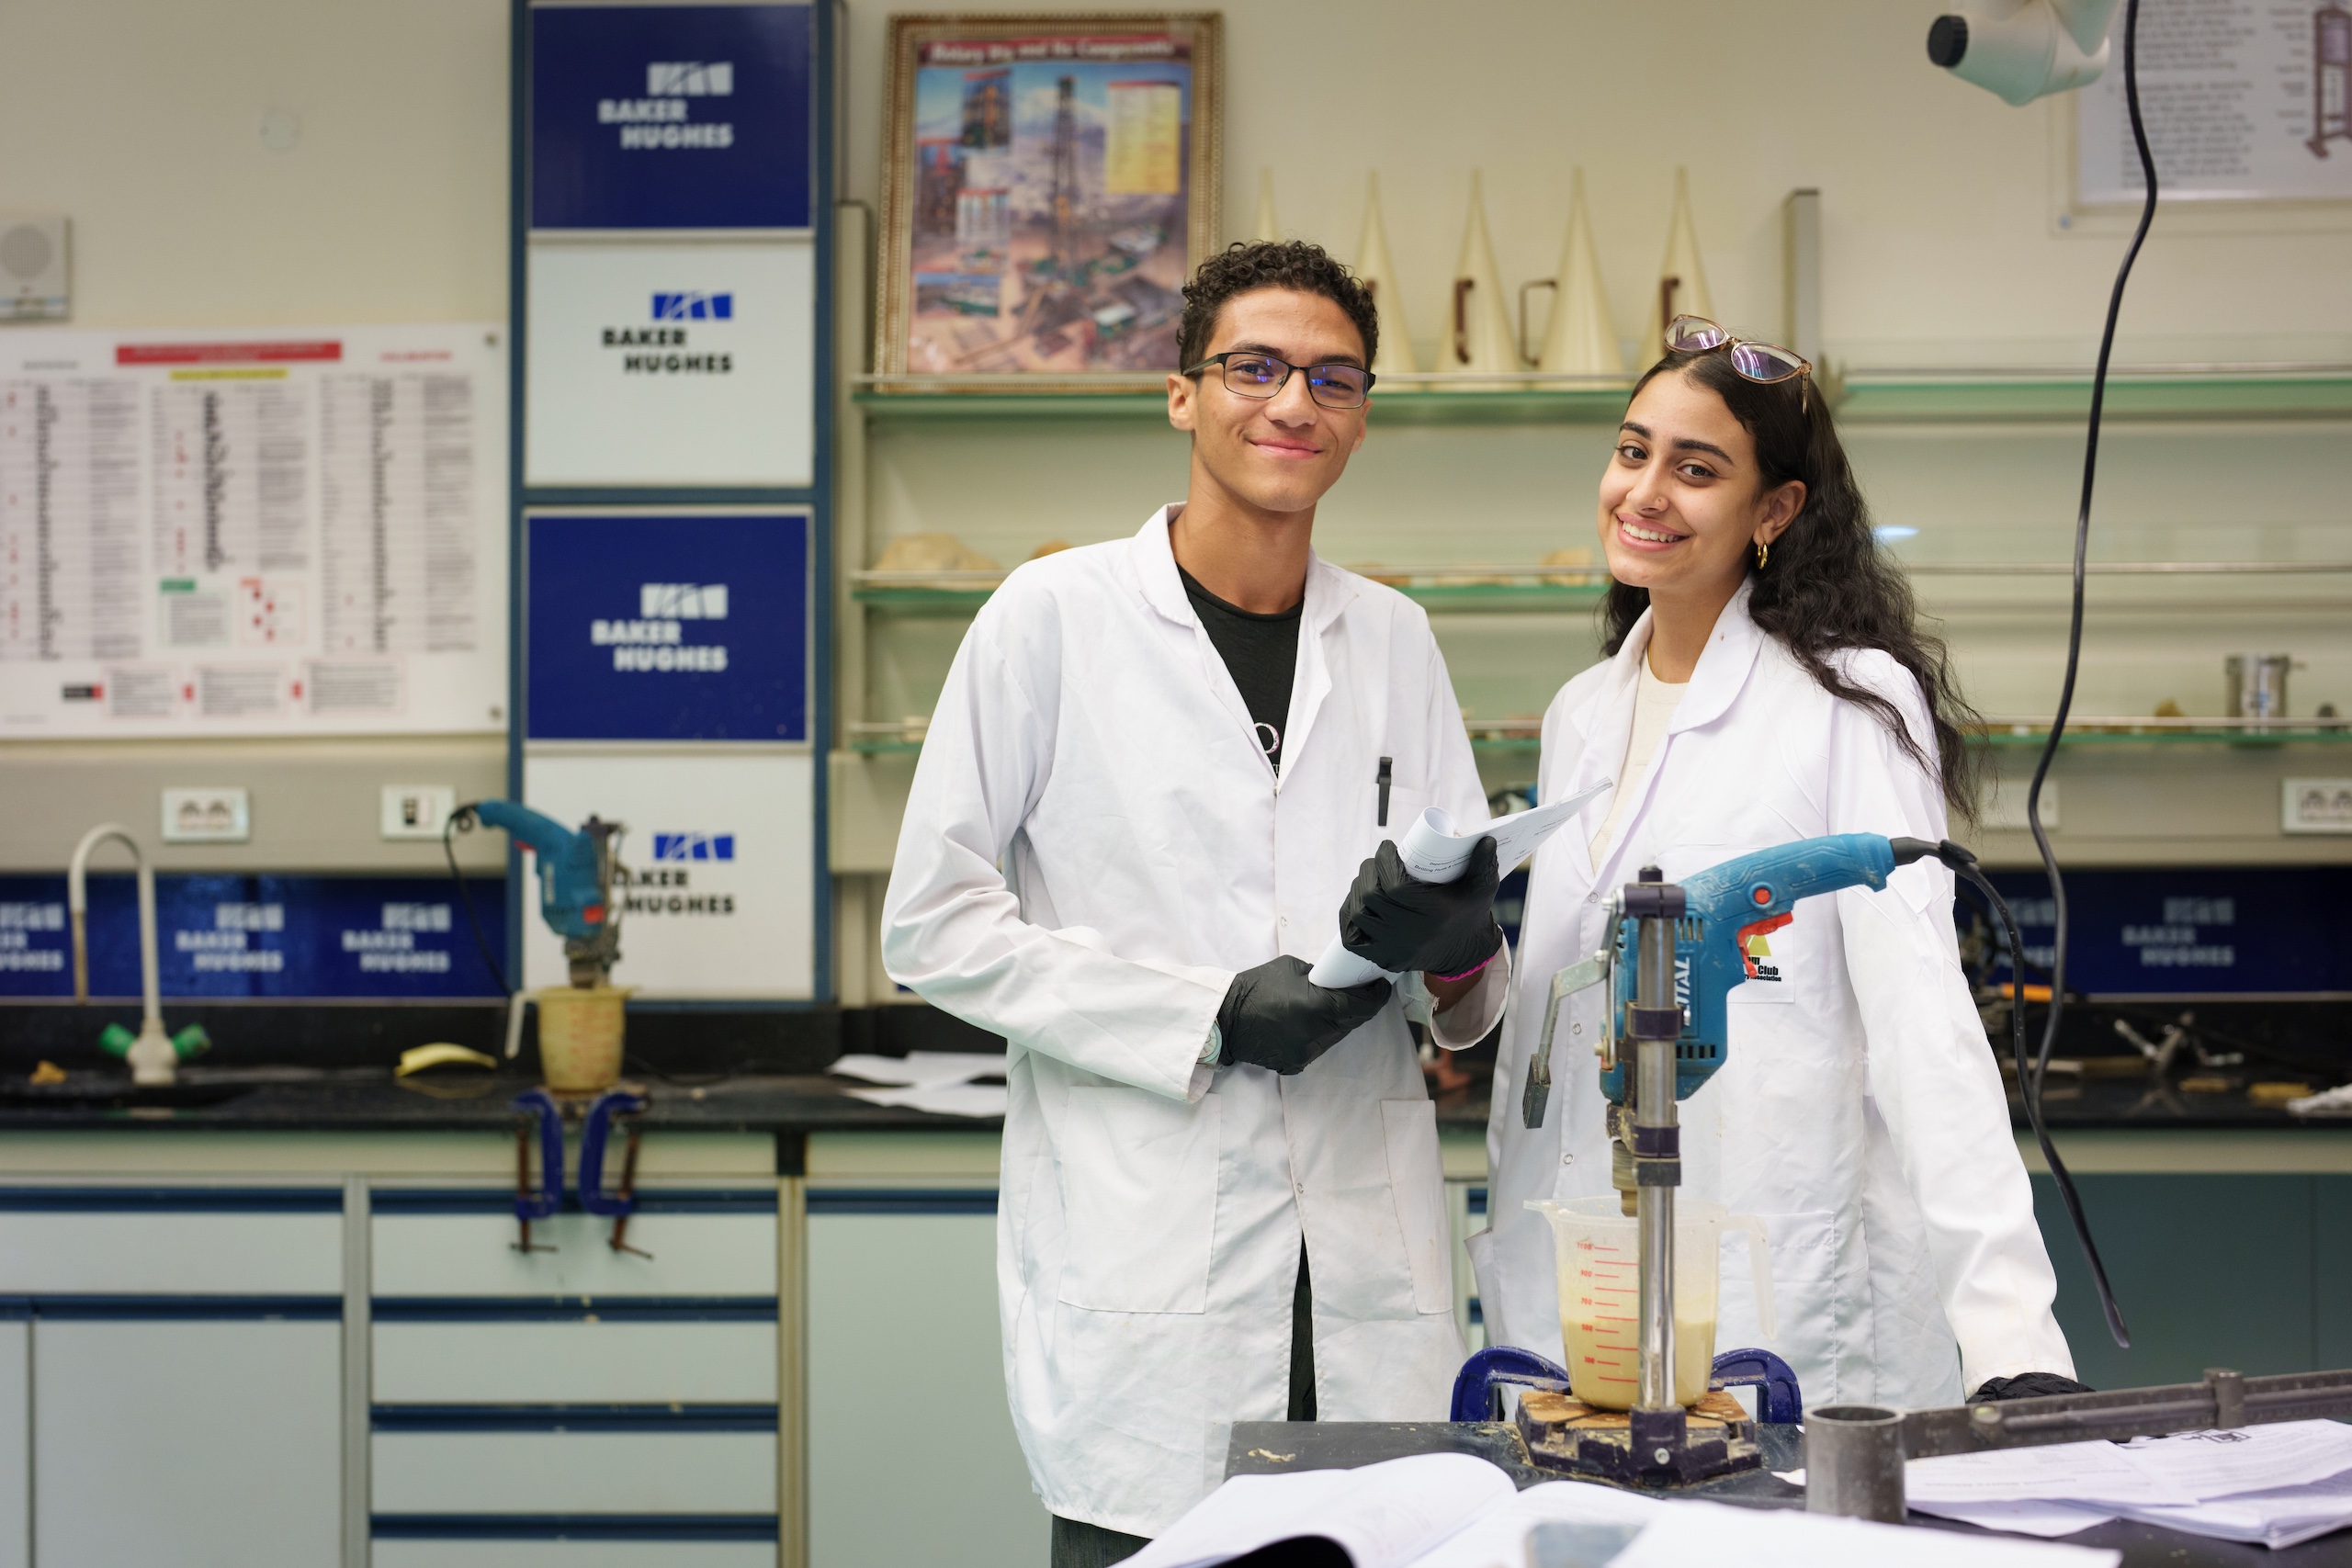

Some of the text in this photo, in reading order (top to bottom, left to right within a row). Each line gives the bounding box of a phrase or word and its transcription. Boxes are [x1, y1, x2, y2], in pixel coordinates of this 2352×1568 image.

[598, 99, 687, 124] BAKER
[620, 123, 734, 149] HUGHES
[602, 327, 687, 348] BAKER
[624, 353, 732, 374] HUGHES
[591, 620, 682, 646] BAKER
[613, 645, 729, 671] HUGHES
[613, 868, 689, 887] KER
[628, 895, 735, 916] HUGHES
[175, 931, 247, 951] BAKER
[342, 931, 413, 951] BAKER
[2122, 926, 2197, 945] BAKER
[193, 951, 284, 972] HUGHES
[360, 951, 450, 972] HUGHES
[2141, 947, 2234, 966] HUGHES
[1758, 965, 1779, 976] Club
